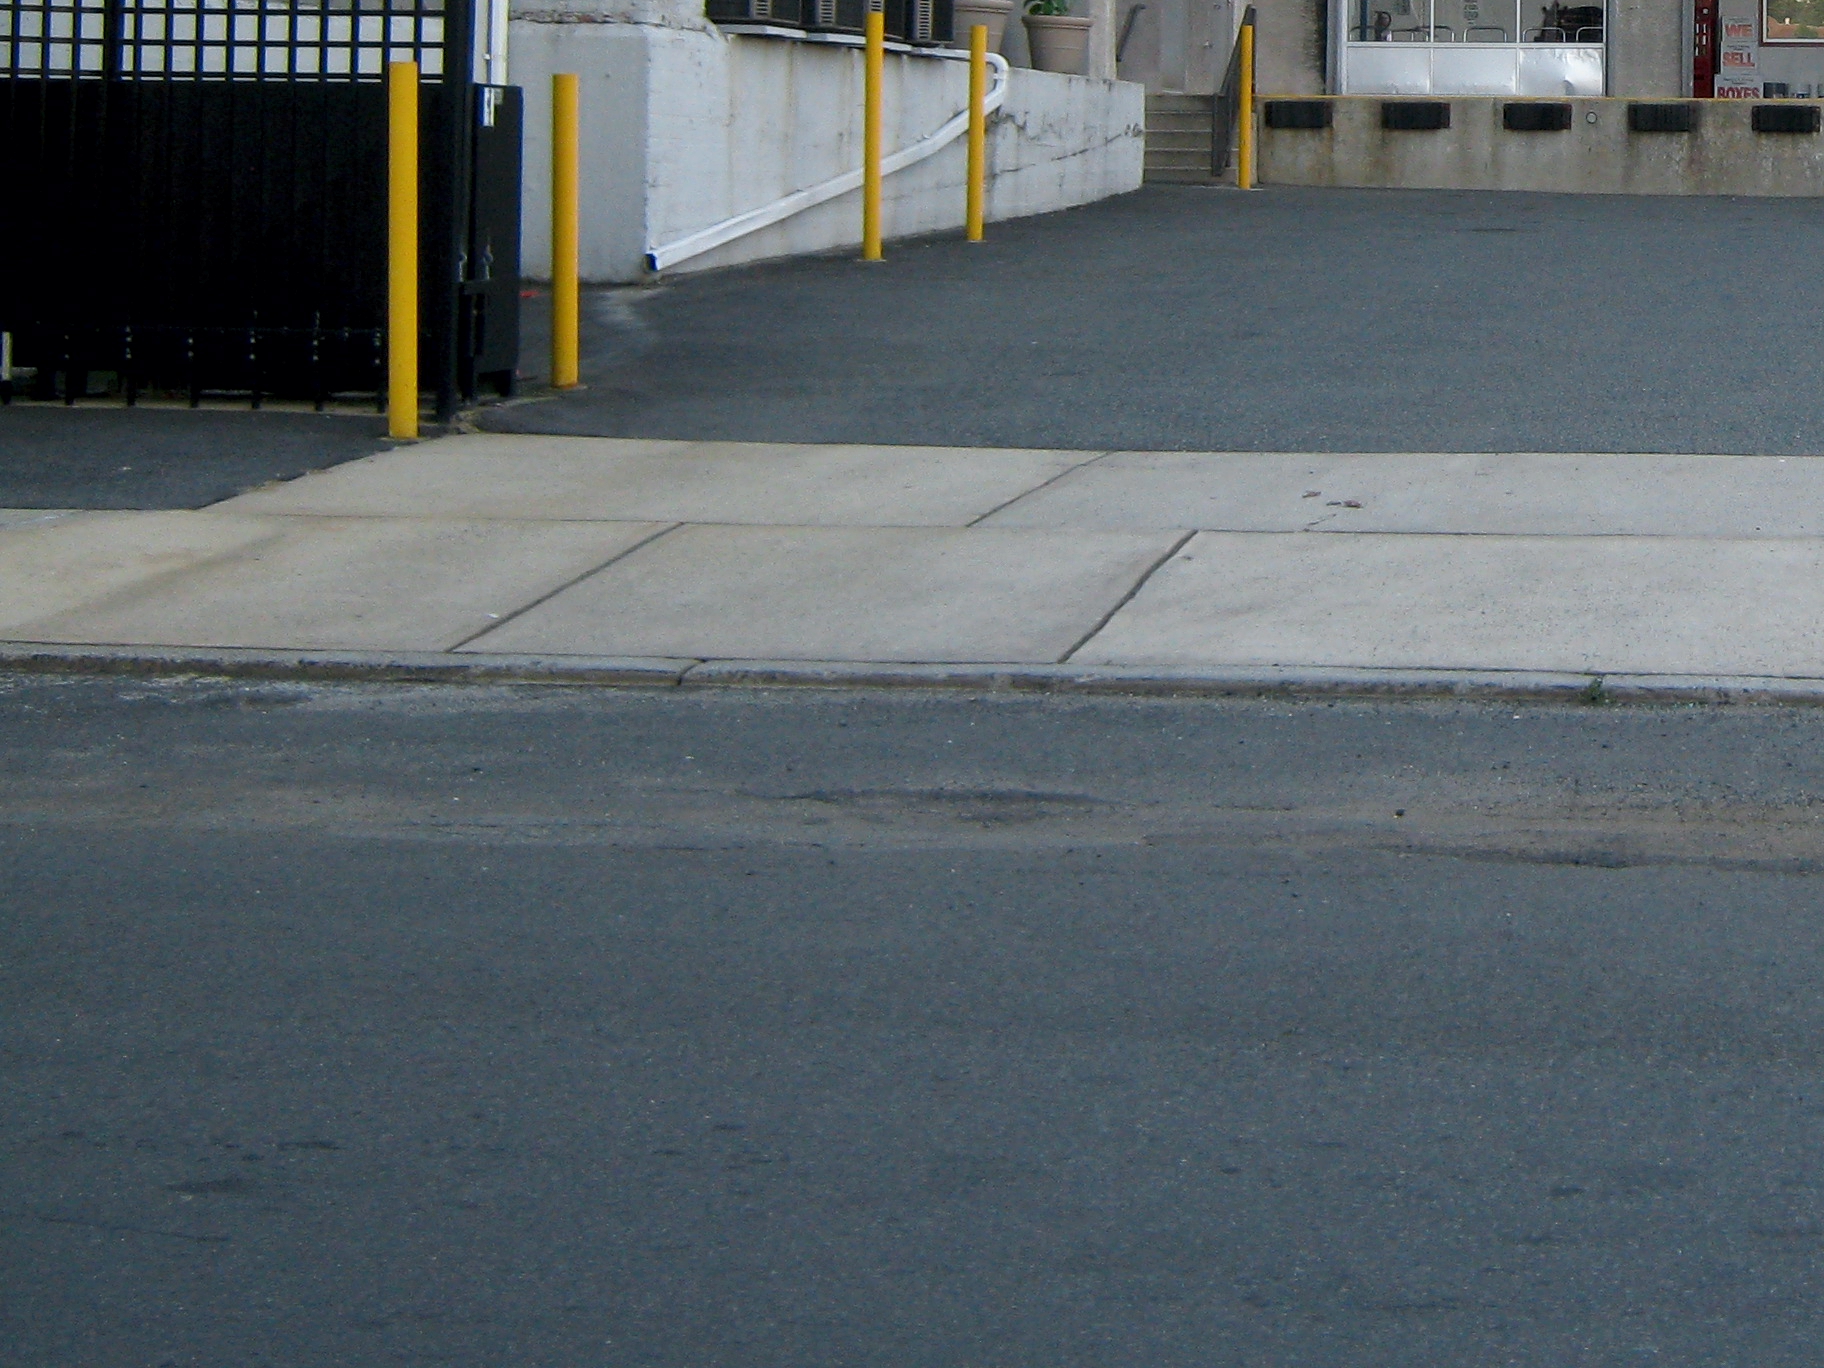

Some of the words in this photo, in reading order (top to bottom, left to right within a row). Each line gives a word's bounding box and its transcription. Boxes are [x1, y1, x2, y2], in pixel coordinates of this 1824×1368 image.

[1725, 23, 1753, 37] WE
[1723, 52, 1756, 67] SELL
[1717, 86, 1760, 98] BOXES
